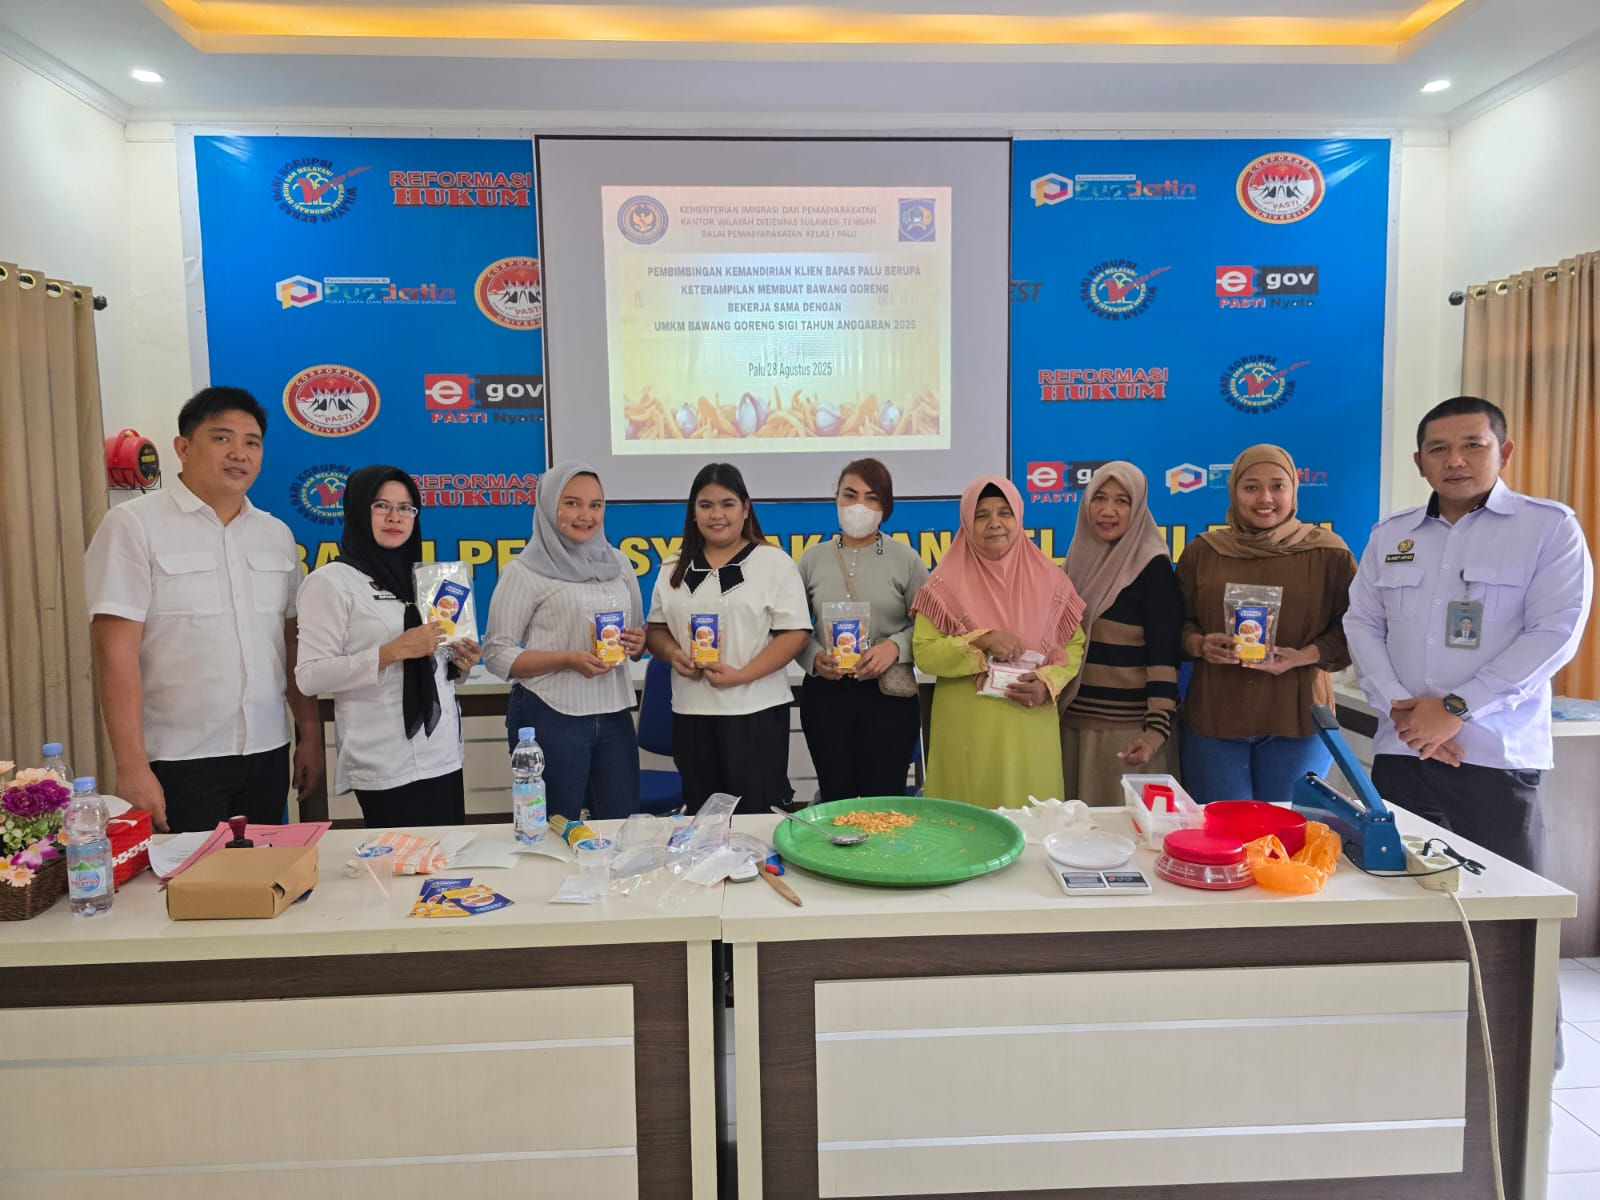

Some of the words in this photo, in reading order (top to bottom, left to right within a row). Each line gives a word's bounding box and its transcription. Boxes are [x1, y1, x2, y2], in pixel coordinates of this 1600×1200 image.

[1249, 156, 1313, 174] CORPORATE
[389, 170, 532, 188] REFORMASI
[1075, 180, 1197, 197] Pusdatin
[393, 187, 530, 207] HUKUM
[680, 206, 738, 214] KEMENTERIAN
[741, 206, 779, 214] IMIGRASI
[782, 206, 799, 214] DAN
[802, 206, 877, 214] PEMASYARAKATAN
[1255, 205, 1311, 220] UNIVERSITY
[681, 218, 714, 226] KANTOR
[718, 218, 754, 226] WILAYAH
[801, 218, 840, 226] SULAWESI
[843, 218, 876, 226] TENGAH
[701, 230, 725, 238] BALAI
[728, 230, 802, 238] PEMASYARAKATAN
[806, 230, 830, 238] KELAS
[837, 230, 857, 238] PALU
[648, 266, 722, 277] PEMBIMBINGAN
[725, 266, 792, 277] KEMANDIRIAN
[794, 266, 823, 276] KLIEN
[825, 266, 855, 276] BAPAS
[858, 266, 882, 276] PALU
[884, 266, 921, 276] BERUPA
[1216, 270, 1247, 292] e
[1266, 273, 1314, 289] gov
[324, 283, 456, 300] Pusdatin
[681, 285, 755, 295] KETERAMPILAN
[758, 284, 804, 294] MEMBUAT
[806, 284, 847, 294] BAWANG
[850, 284, 889, 294] GORENG
[728, 302, 771, 312] BEKERJA
[774, 302, 800, 312] SAMA
[803, 302, 842, 312] DENGAN
[1219, 298, 1266, 308] PASTI
[654, 321, 685, 331] UMKM
[688, 321, 731, 331] BAWANG
[734, 321, 775, 331] GORENG
[778, 320, 798, 330] SIGI
[801, 320, 834, 330] TAHUN
[837, 320, 891, 330] ANGGARAN
[894, 320, 917, 330] 2025
[295, 369, 364, 386] CORPORATE
[748, 362, 765, 376] Palu
[767, 362, 778, 376] 28
[780, 362, 811, 379] Agustus
[813, 362, 833, 376] 2025
[1038, 367, 1169, 385] REFORMASI
[425, 380, 463, 405] e
[486, 383, 543, 402] gov
[1041, 383, 1166, 401] HUKUM
[324, 413, 353, 423] PASTI
[431, 412, 488, 423] PASTI
[306, 419, 367, 433] UNIVERSITY
[410, 473, 541, 489] REFORMAS
[1027, 466, 1058, 487] e
[1030, 492, 1077, 503] PASTI
